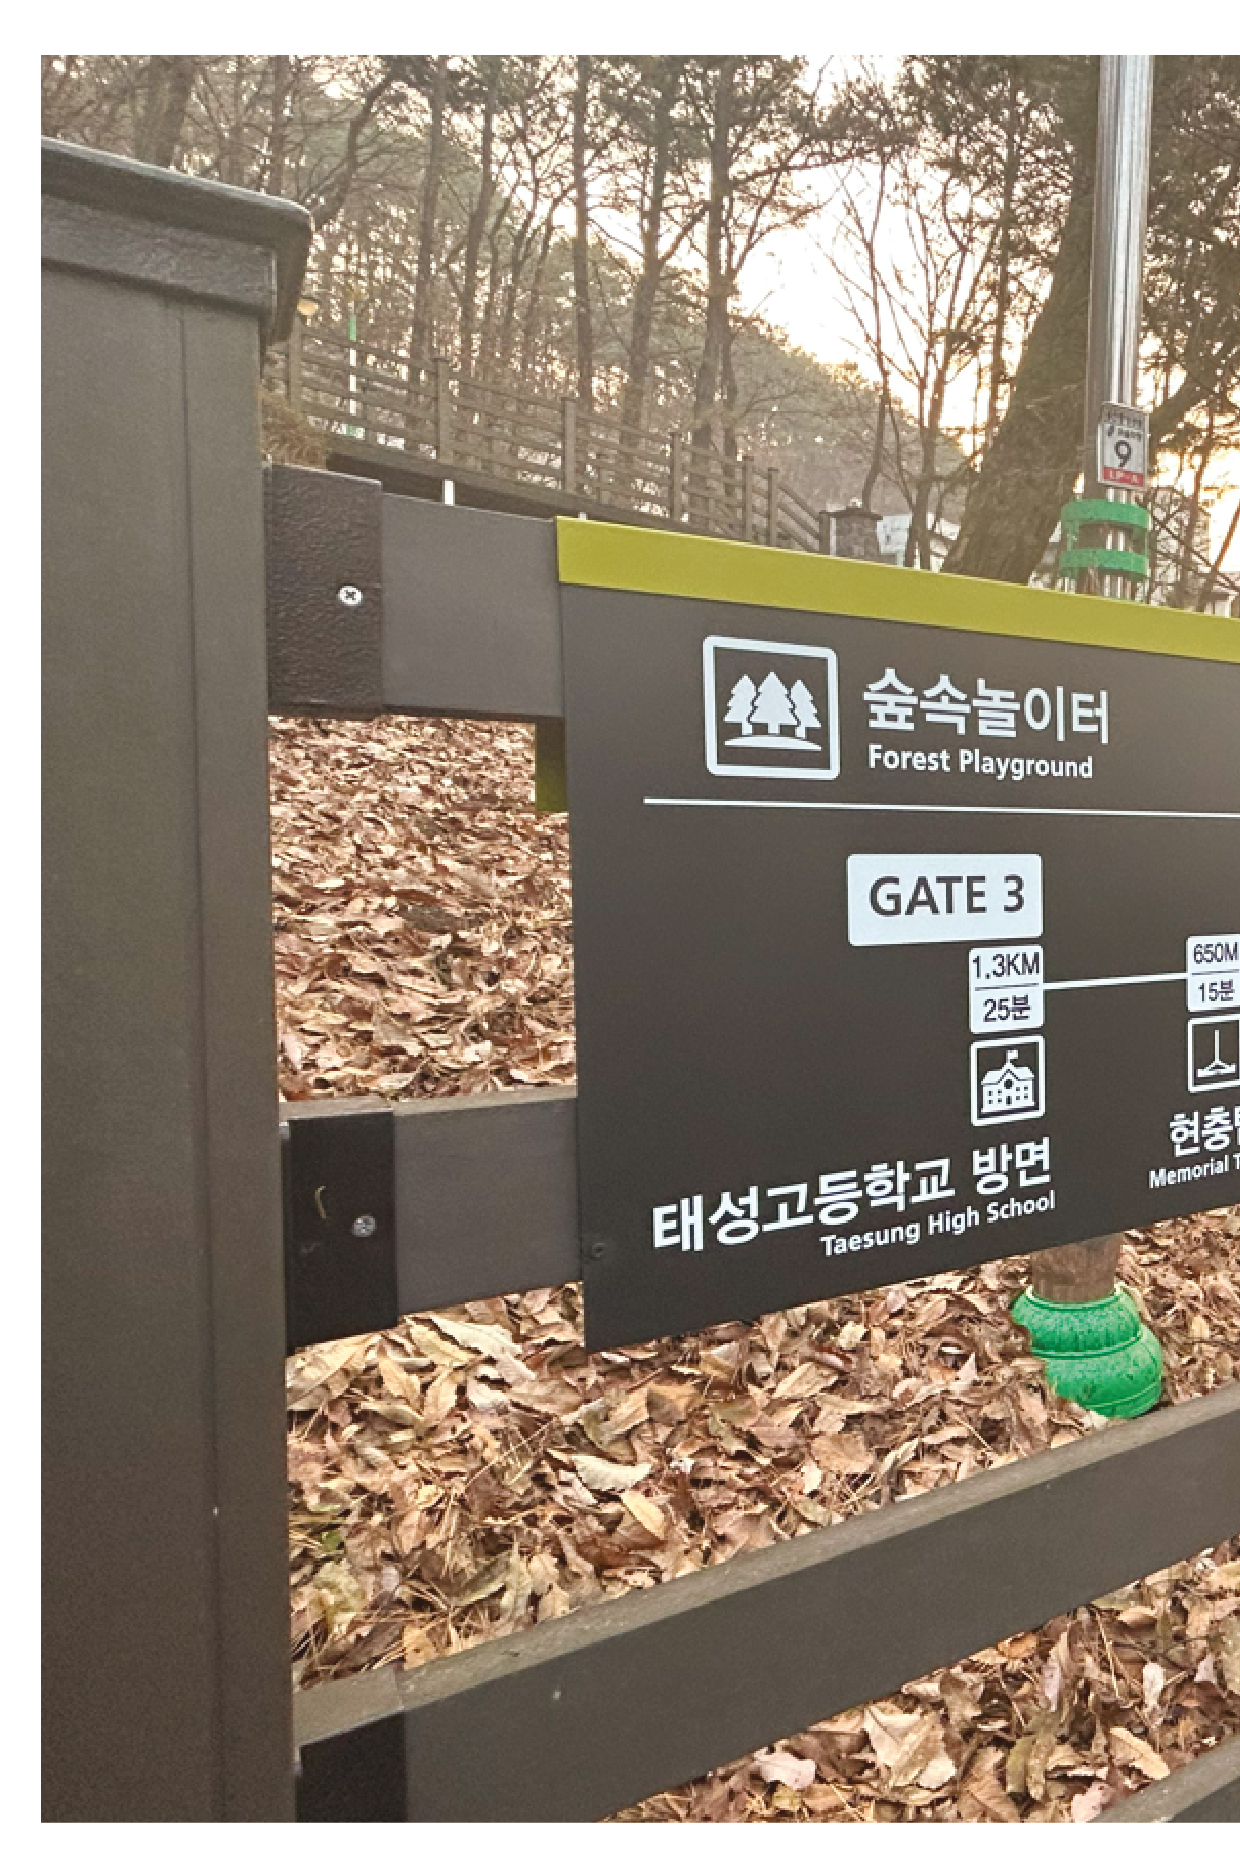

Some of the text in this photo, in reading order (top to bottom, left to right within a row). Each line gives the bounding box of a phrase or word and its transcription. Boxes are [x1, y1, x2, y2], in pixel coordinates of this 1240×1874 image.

[1113, 440, 1132, 467] 9
[863, 667, 1109, 745] 숲속놀이터
[868, 744, 1093, 780] Forest Playground
[869, 874, 1025, 917] GATE 3
[972, 952, 1040, 980] 1.3KM
[1193, 942, 1238, 964] 650M
[983, 995, 1031, 1022] 25분
[1198, 980, 1235, 1003] 15분
[1149, 1154, 1230, 1189] Memorial
[652, 1137, 1051, 1252] 태성고등학교 방면
[820, 1189, 1056, 1257] Taesung High School
